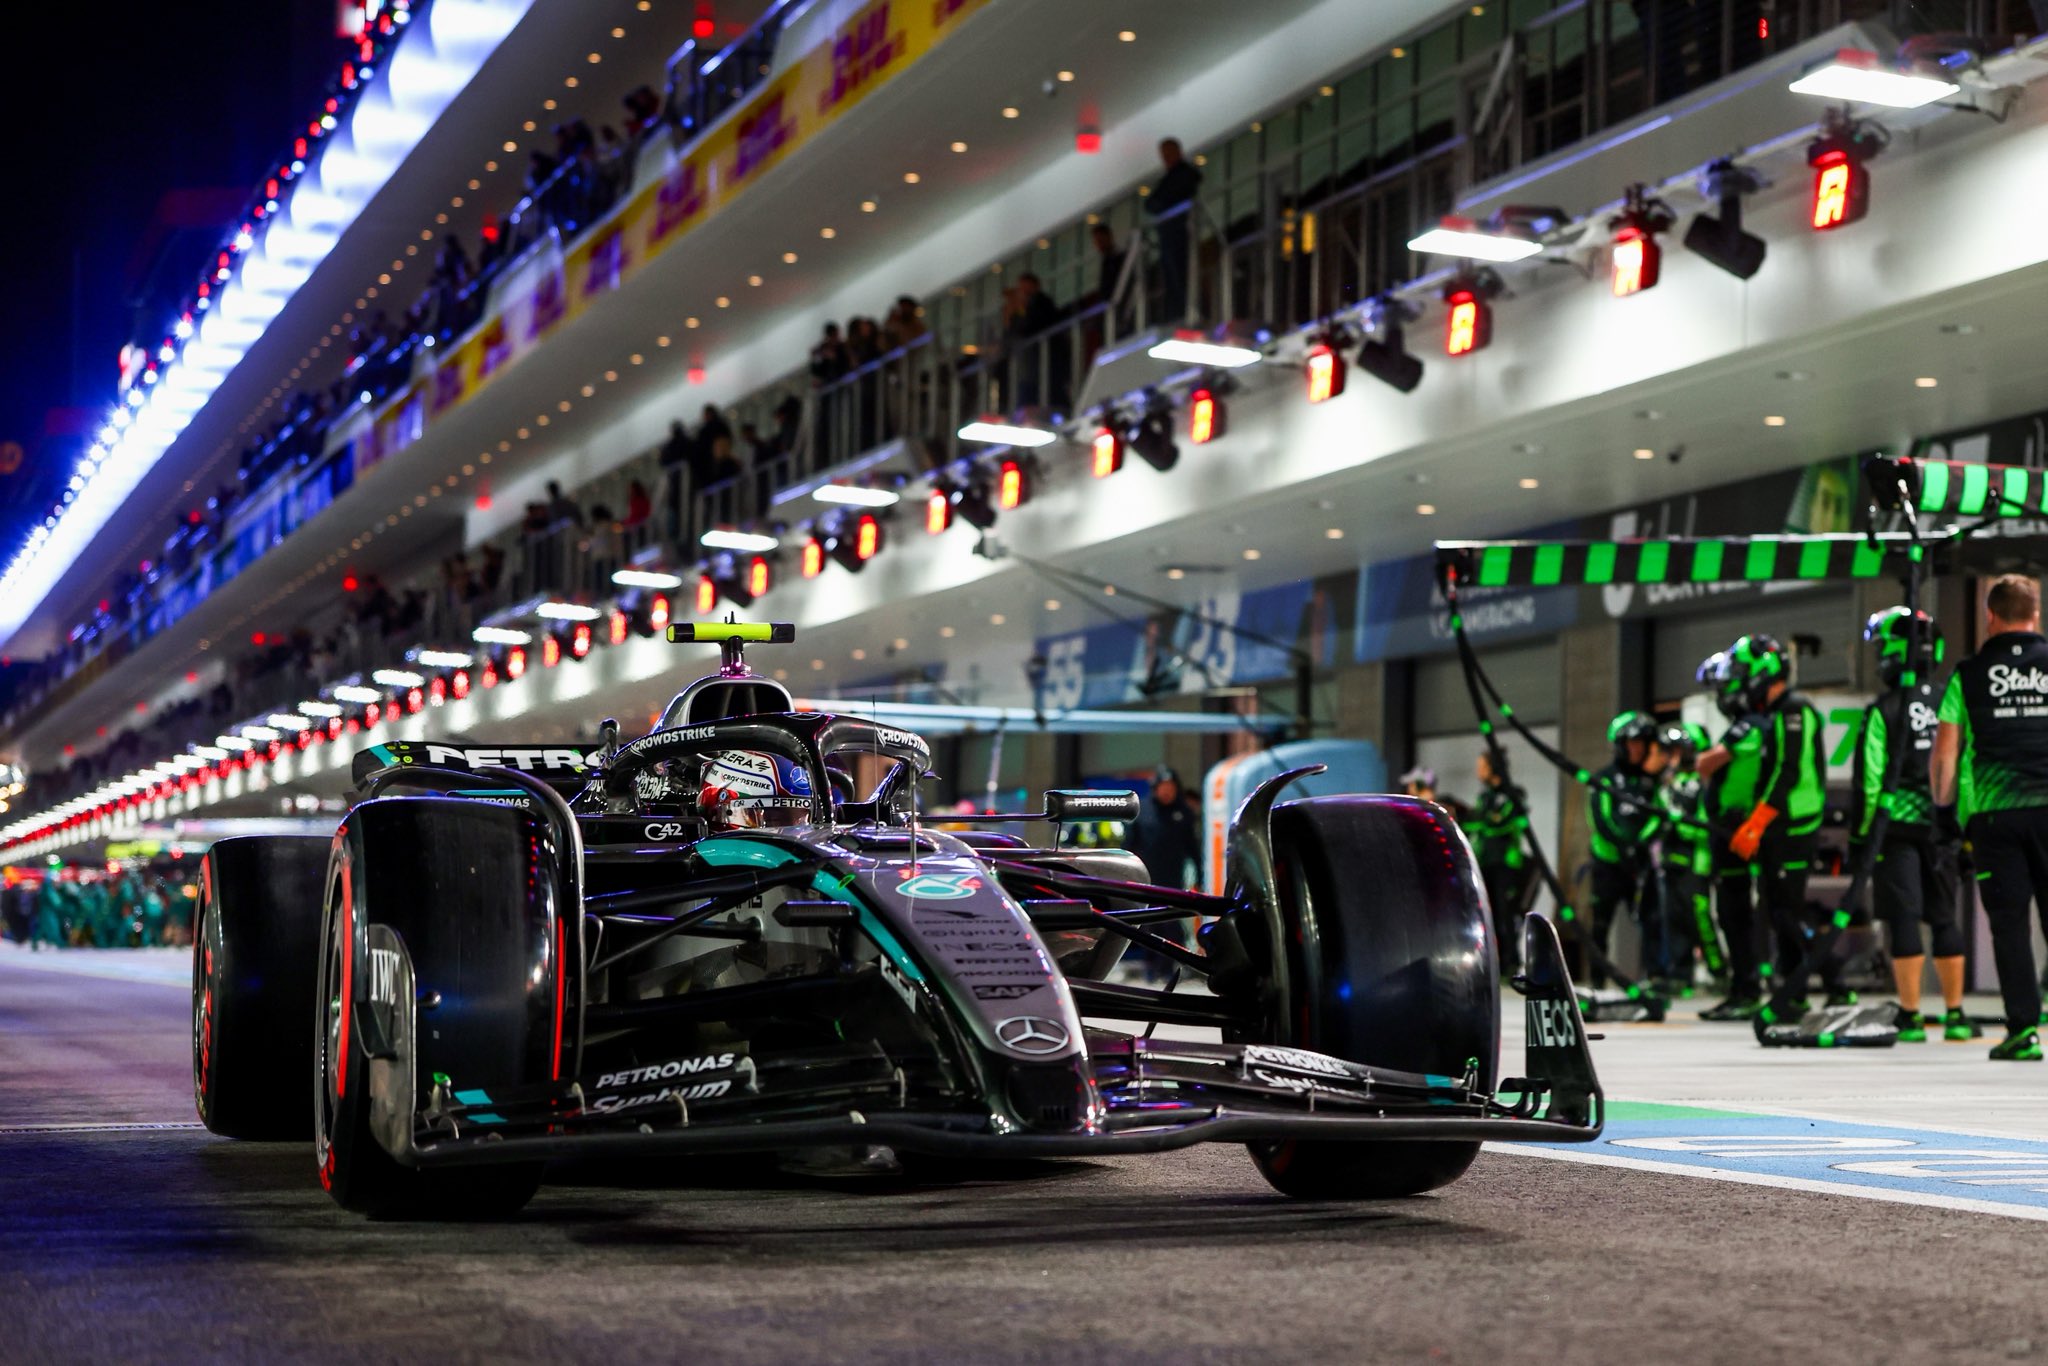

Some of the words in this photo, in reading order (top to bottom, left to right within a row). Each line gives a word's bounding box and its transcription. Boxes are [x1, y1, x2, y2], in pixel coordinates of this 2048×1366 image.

[633, 726, 715, 751] CROWDSTRIKE
[720, 750, 753, 768] LERA
[1074, 797, 1127, 807] PETRONAS
[645, 823, 683, 841] G42
[1527, 1000, 1577, 1048] INEOS
[596, 1053, 735, 1088] PETRONAS
[1247, 1045, 1351, 1076] PETRONAS
[593, 1079, 732, 1114] Syntum
